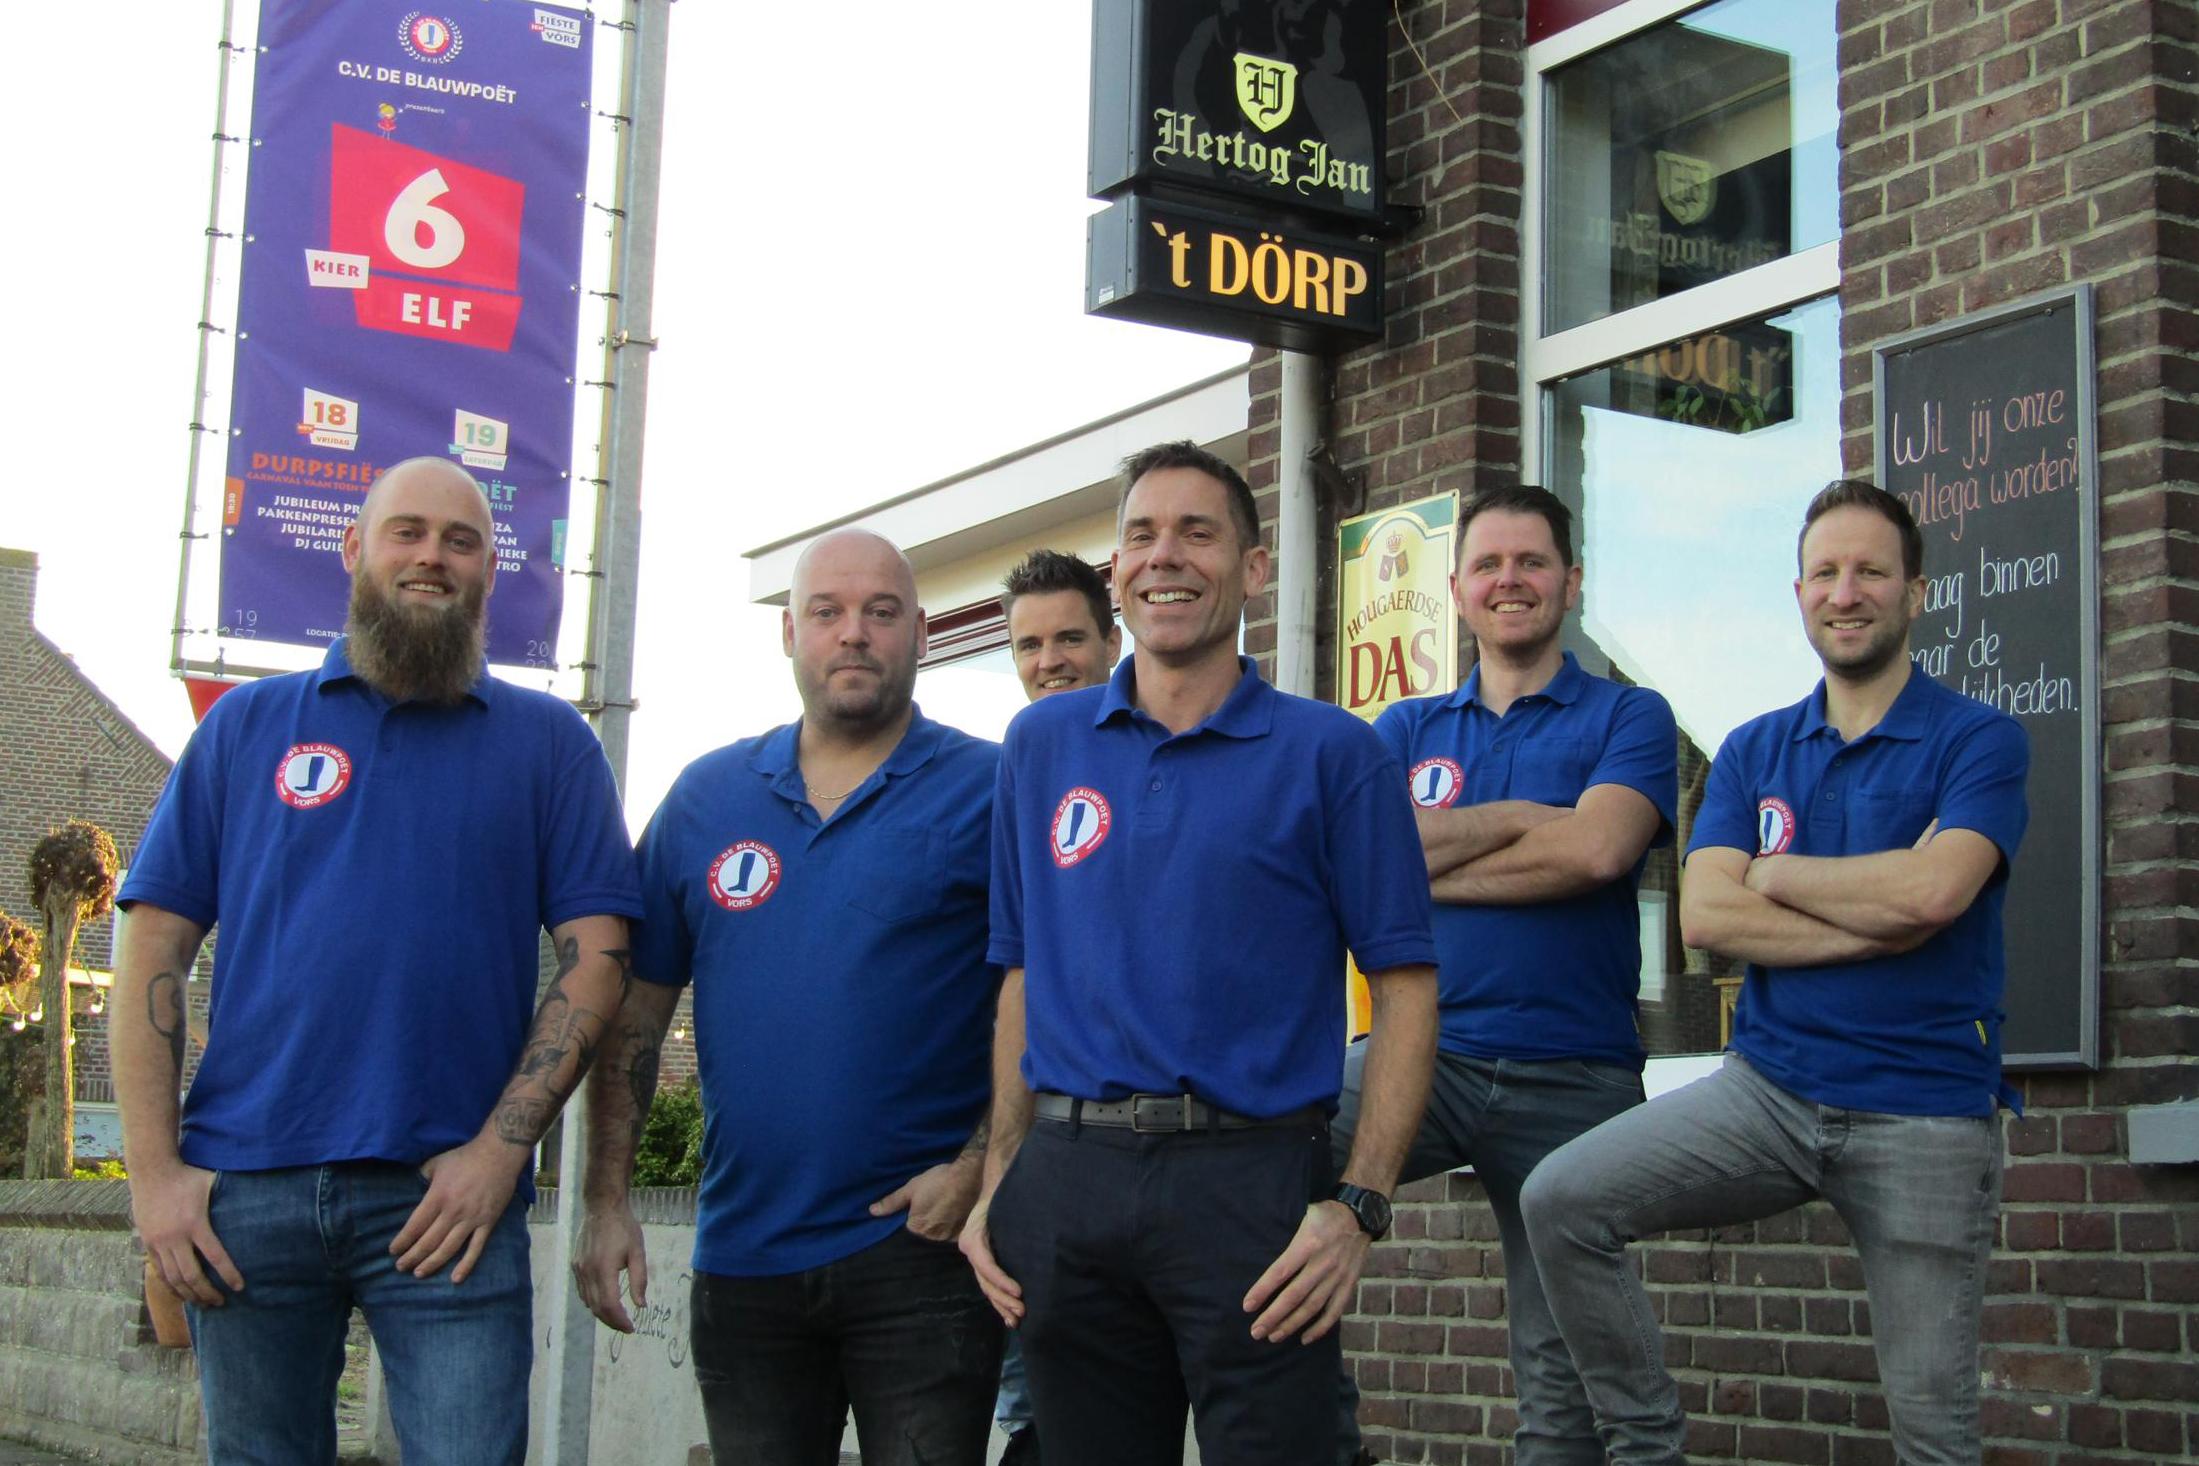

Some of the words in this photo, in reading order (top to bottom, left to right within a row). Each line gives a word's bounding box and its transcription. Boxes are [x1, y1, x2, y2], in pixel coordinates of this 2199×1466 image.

[540, 16, 575, 30] FIESTE
[338, 61, 372, 80] C.V.
[377, 67, 401, 84] DE
[405, 72, 517, 104] BLAUWPOËT
[1153, 107, 1292, 186] Hertog
[1297, 138, 1371, 196] Jan
[385, 168, 465, 269] 6
[313, 259, 360, 278] KIER
[1210, 232, 1368, 316] DÖRP
[401, 292, 472, 330] ELF
[314, 401, 346, 426] 18
[1894, 400, 1949, 466] Wil
[1963, 398, 1992, 470] jij
[2004, 389, 2064, 433] onze
[464, 422, 496, 447] 19
[274, 495, 341, 513] JUBILEUM
[295, 538, 311, 550] DJ
[1980, 547, 2058, 597] binnen
[235, 609, 258, 626] 19
[1347, 590, 1442, 642] HOUGAERDSE
[527, 639, 549, 657] 20
[1968, 618, 2000, 668] de
[1349, 628, 1438, 708] DAS
